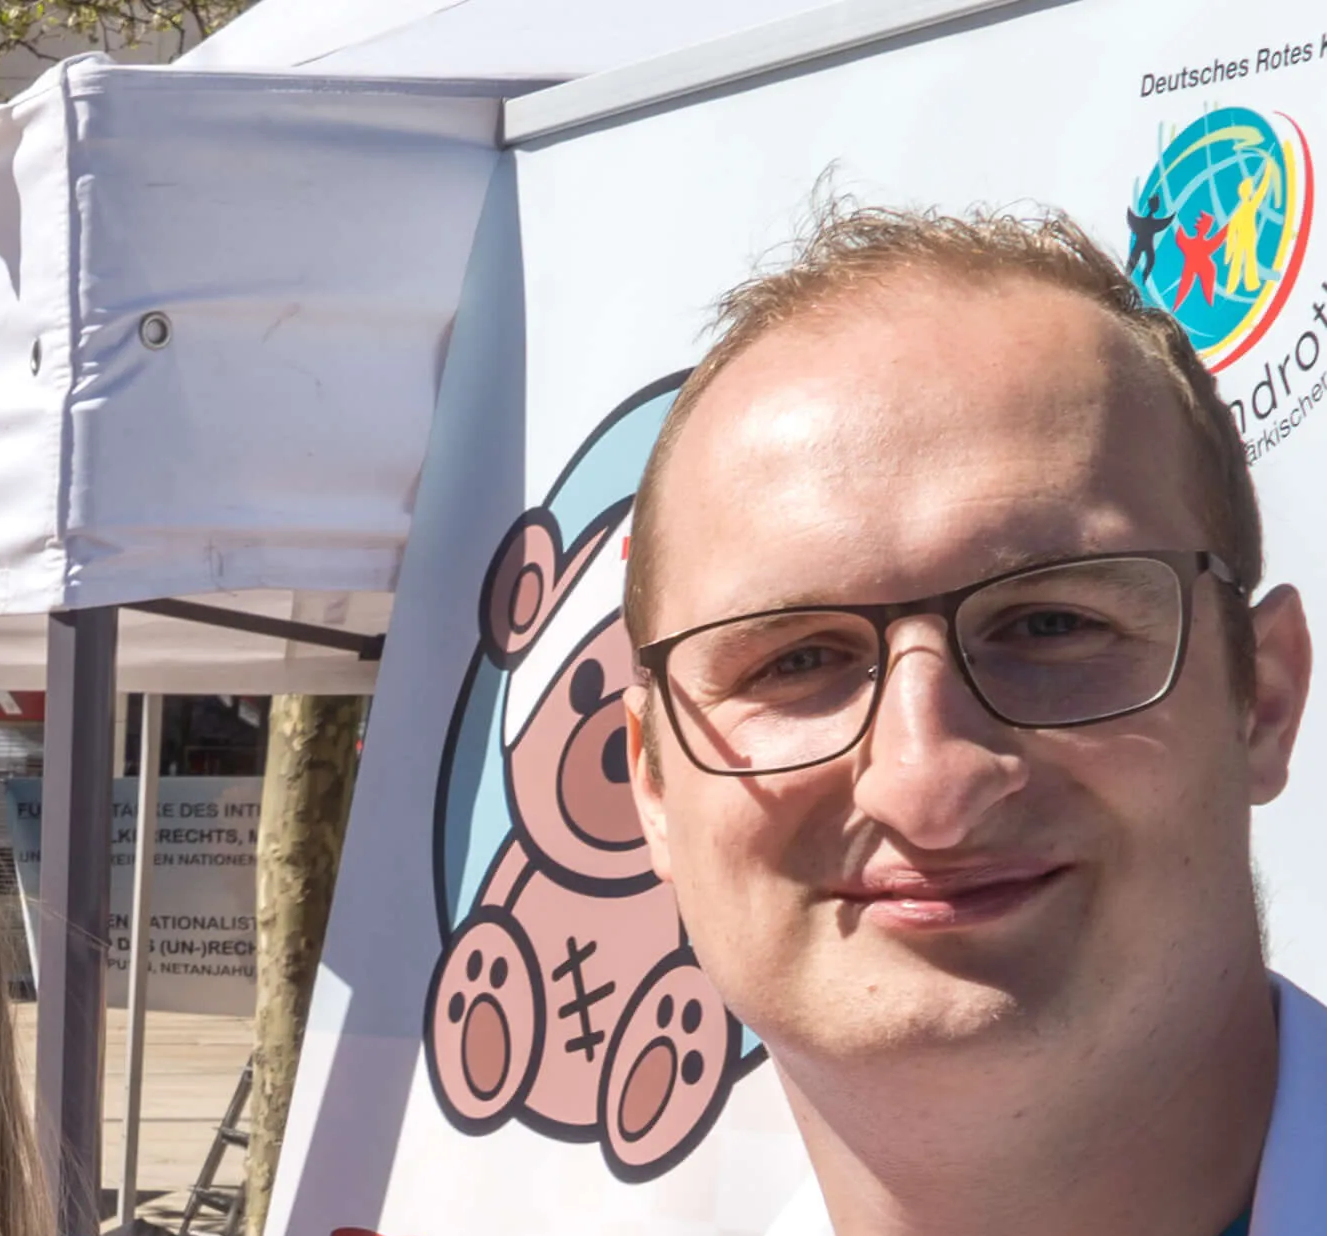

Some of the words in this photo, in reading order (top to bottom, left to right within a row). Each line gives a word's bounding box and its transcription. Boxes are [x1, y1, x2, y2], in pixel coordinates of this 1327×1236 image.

[1140, 58, 1249, 98] Deutsches
[1255, 42, 1314, 75] Rotes
[179, 802, 220, 819] DES
